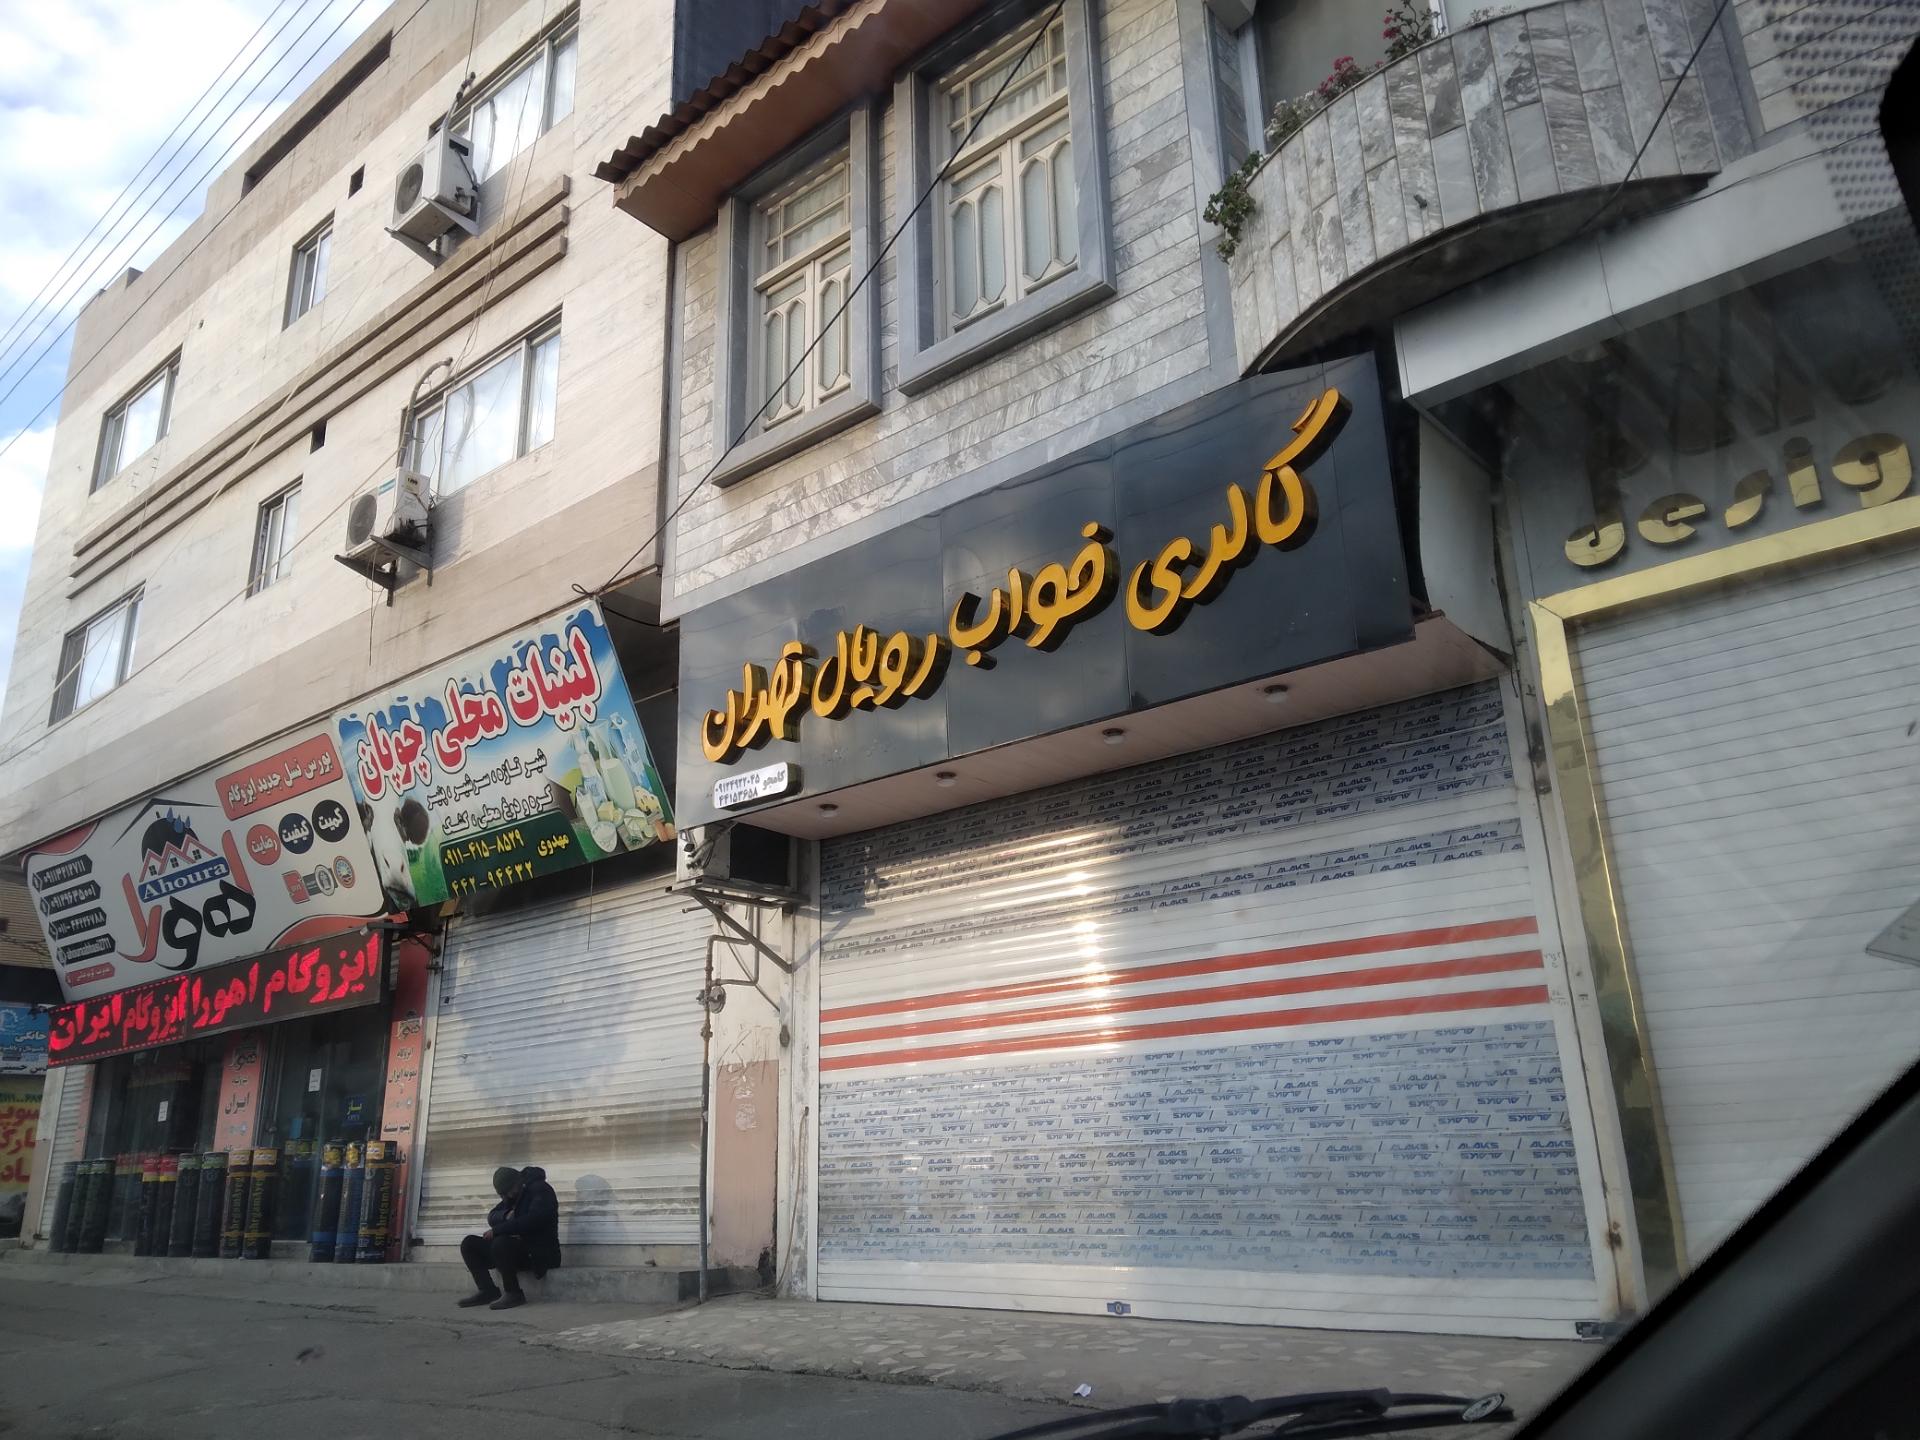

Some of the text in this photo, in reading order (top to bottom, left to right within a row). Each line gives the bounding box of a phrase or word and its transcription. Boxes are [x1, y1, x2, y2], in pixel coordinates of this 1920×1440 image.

[701, 387, 1345, 764] گالری خواب رویال تهران
[358, 627, 600, 799] لبنیات محلی چوپان
[1402, 714, 1440, 727] ALAKS
[525, 748, 548, 779] شیر
[1244, 767, 1276, 777] ALAKS
[1299, 754, 1333, 765] ALAKS
[1351, 757, 1387, 768] ALAKS
[1412, 743, 1450, 755] ALAKS
[227, 752, 334, 808] بورس نسل جدید ایزوگام
[1336, 776, 1372, 787] ALAKS
[1396, 763, 1434, 775] ALAKS
[528, 784, 554, 812] کره
[281, 819, 311, 844] کیفیت
[318, 808, 344, 831] کمیت
[251, 835, 279, 855] رضایت
[537, 833, 571, 857] مهدوی
[1171, 882, 1201, 890] ALAKS
[1222, 873, 1254, 882] ALAKS
[1276, 863, 1310, 872] ALAKS
[1333, 853, 1369, 863] ALAKS
[1393, 842, 1432, 852] ALAKS
[1457, 830, 1498, 841] ALAKS
[143, 862, 229, 900] Ahoura
[1209, 890, 1240, 898] ALAKS
[1263, 880, 1296, 889] ALAKS
[1319, 871, 1355, 880] ALAKS
[1379, 860, 1416, 870] ALAKS
[1443, 849, 1483, 860] ALAKS
[192, 933, 380, 1029] ایزوگام اهورا
[51, 976, 190, 1051] ایزوگام ایران
[1283, 1076, 1381, 1088] ALAKS ALAKS
[1456, 1141, 1499, 1149] ALAKS
[1519, 1233, 1565, 1241] ALAKS
